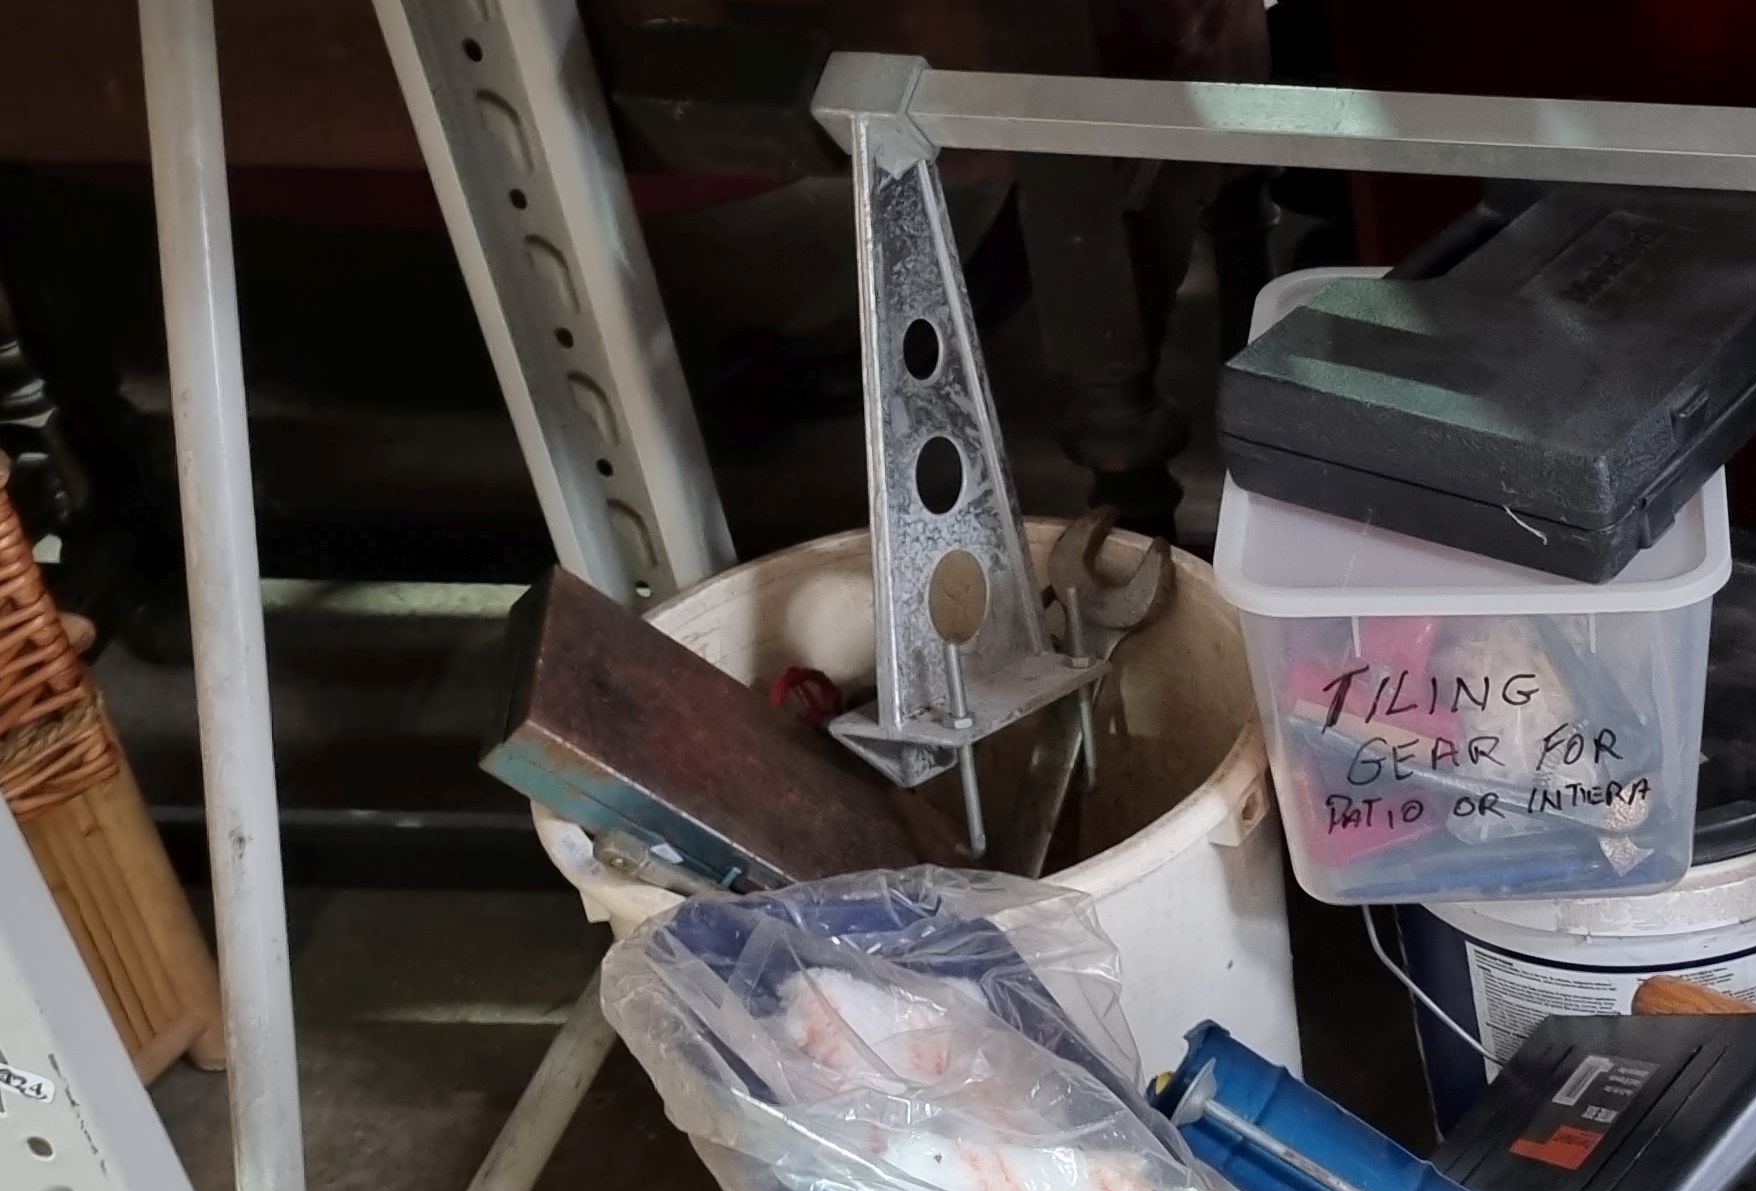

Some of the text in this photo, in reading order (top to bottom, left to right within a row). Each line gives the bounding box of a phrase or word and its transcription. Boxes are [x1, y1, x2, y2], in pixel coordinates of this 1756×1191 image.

[1323, 665, 1541, 735] TILING
[1347, 723, 1624, 786] GEAR FOR
[1326, 794, 1424, 834] PATIO
[1453, 793, 1505, 817] OR
